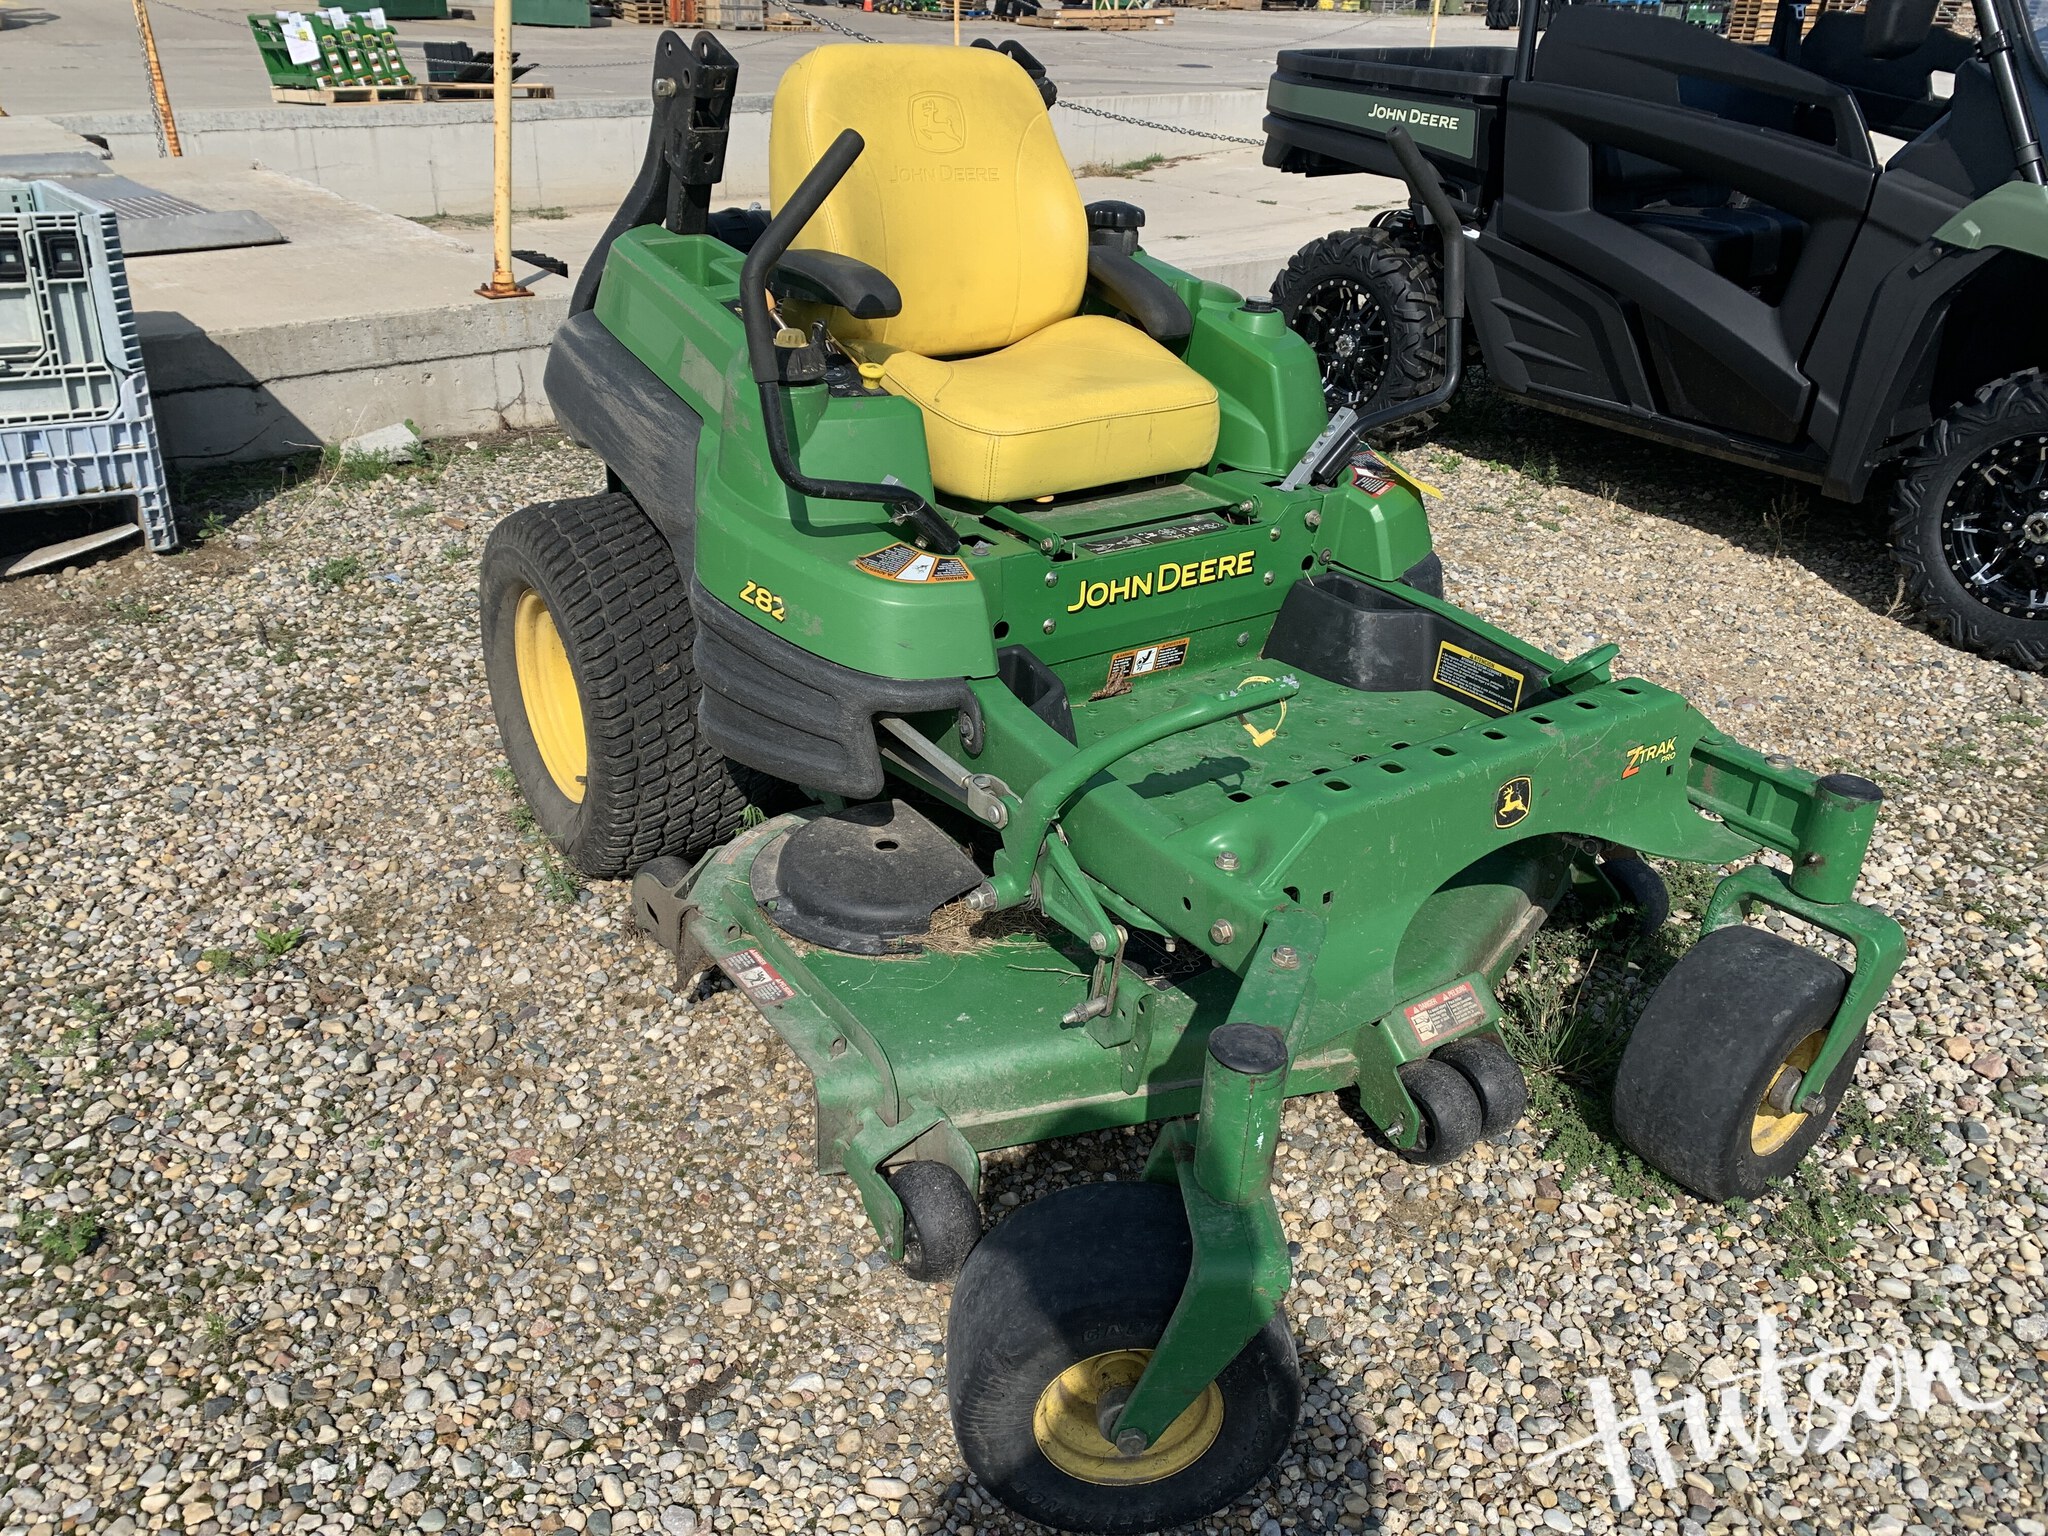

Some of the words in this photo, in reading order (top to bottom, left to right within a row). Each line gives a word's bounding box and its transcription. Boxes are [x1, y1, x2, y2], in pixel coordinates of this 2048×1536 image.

[1367, 103, 1407, 122] JOHN
[1409, 108, 1460, 130] DEERE
[889, 164, 936, 183] JOHN
[939, 163, 1000, 182] DEERE
[1067, 572, 1153, 614] JOHN
[1157, 550, 1256, 595] DEERE
[1660, 751, 1677, 764] PRO
[1447, 985, 1467, 998] PELIGRO
